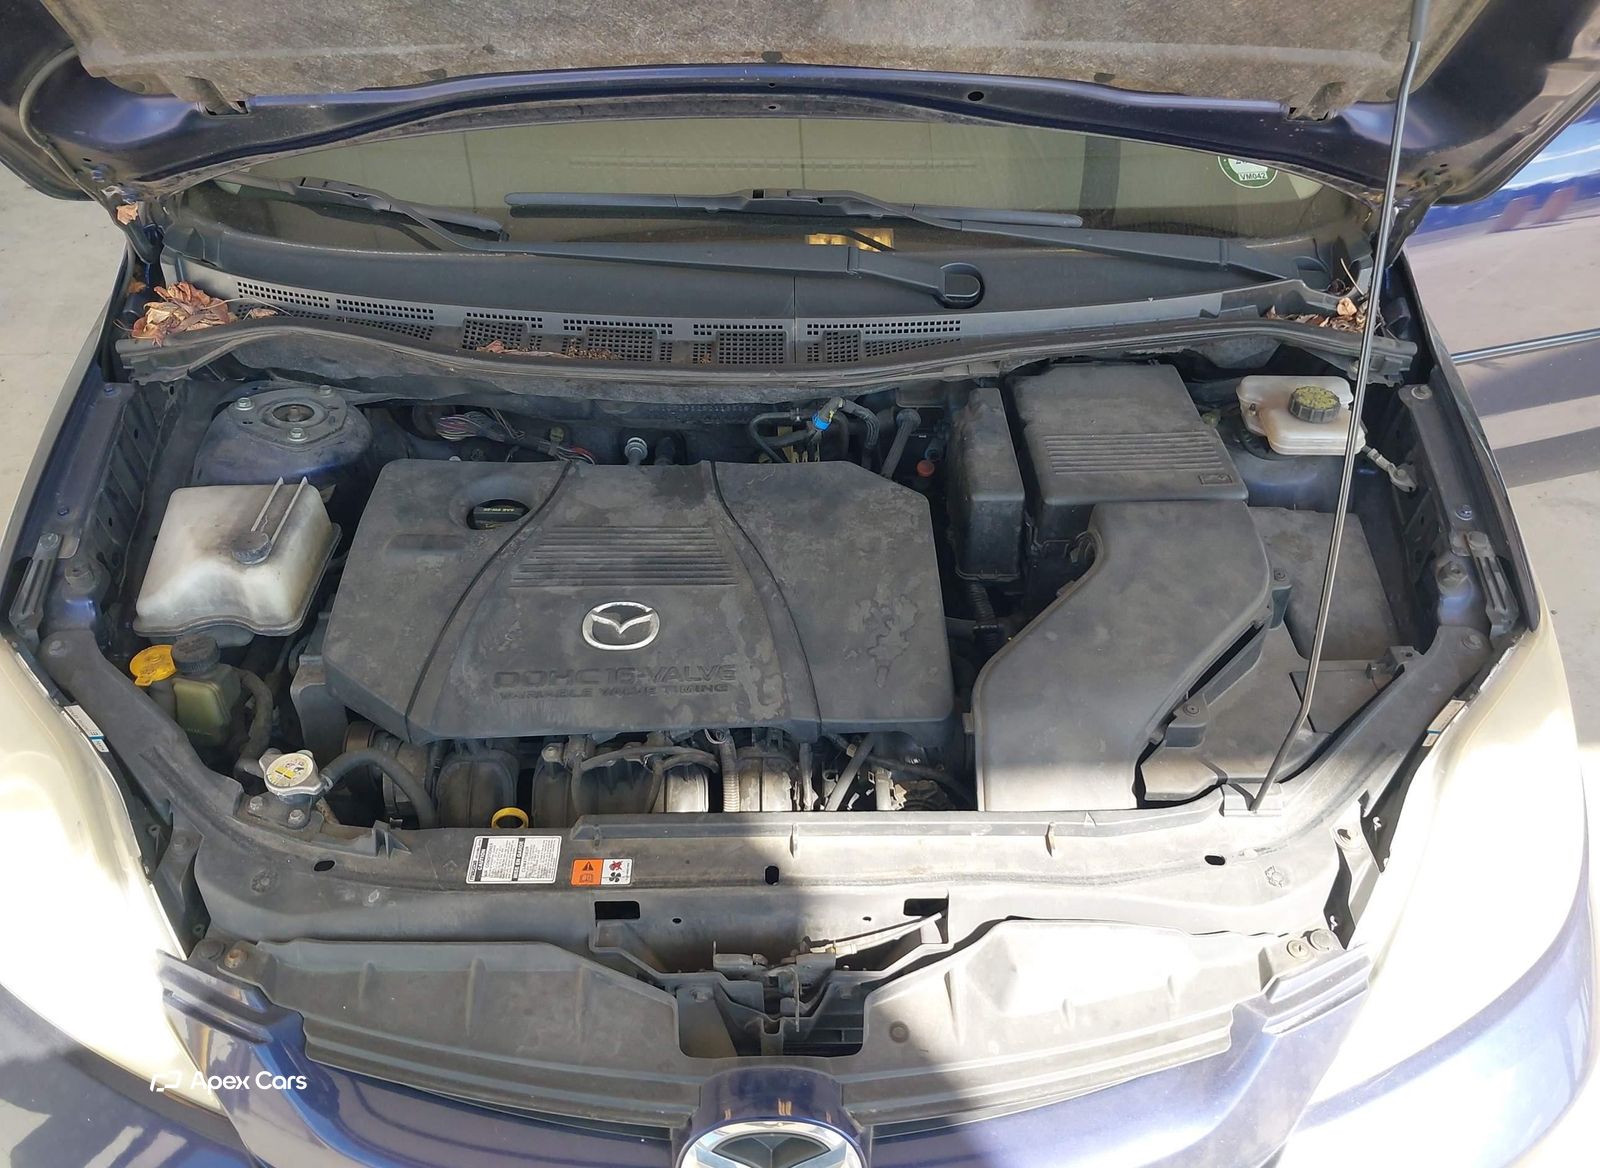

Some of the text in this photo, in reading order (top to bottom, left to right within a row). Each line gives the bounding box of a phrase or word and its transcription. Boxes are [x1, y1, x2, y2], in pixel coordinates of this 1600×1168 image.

[1240, 172, 1267, 180] VM042
[493, 664, 737, 688] DOHC 16-VALVE
[664, 683, 728, 695] TIMING
[477, 848, 487, 871] CAUTION
